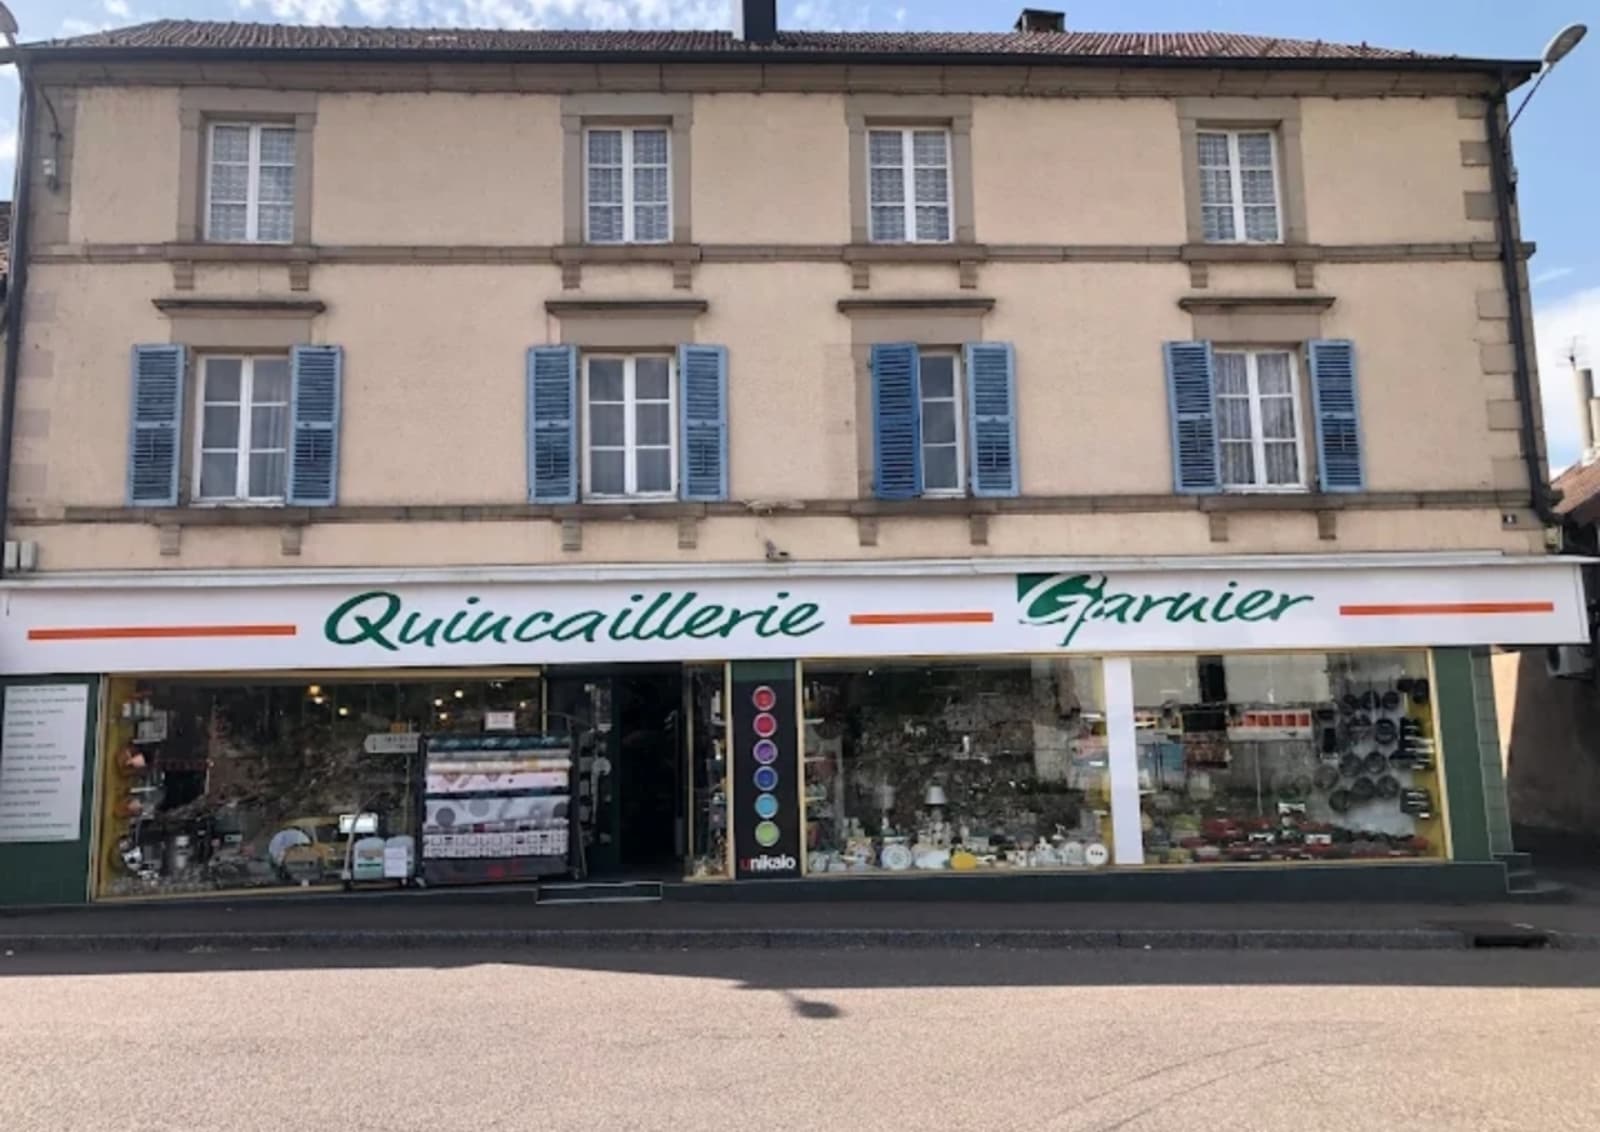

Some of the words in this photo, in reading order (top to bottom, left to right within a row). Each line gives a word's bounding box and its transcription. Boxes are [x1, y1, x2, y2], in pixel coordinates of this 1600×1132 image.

[323, 590, 824, 651] Quincaillerie
[1016, 573, 1315, 648] Garnier
[740, 853, 797, 871] unikalo
